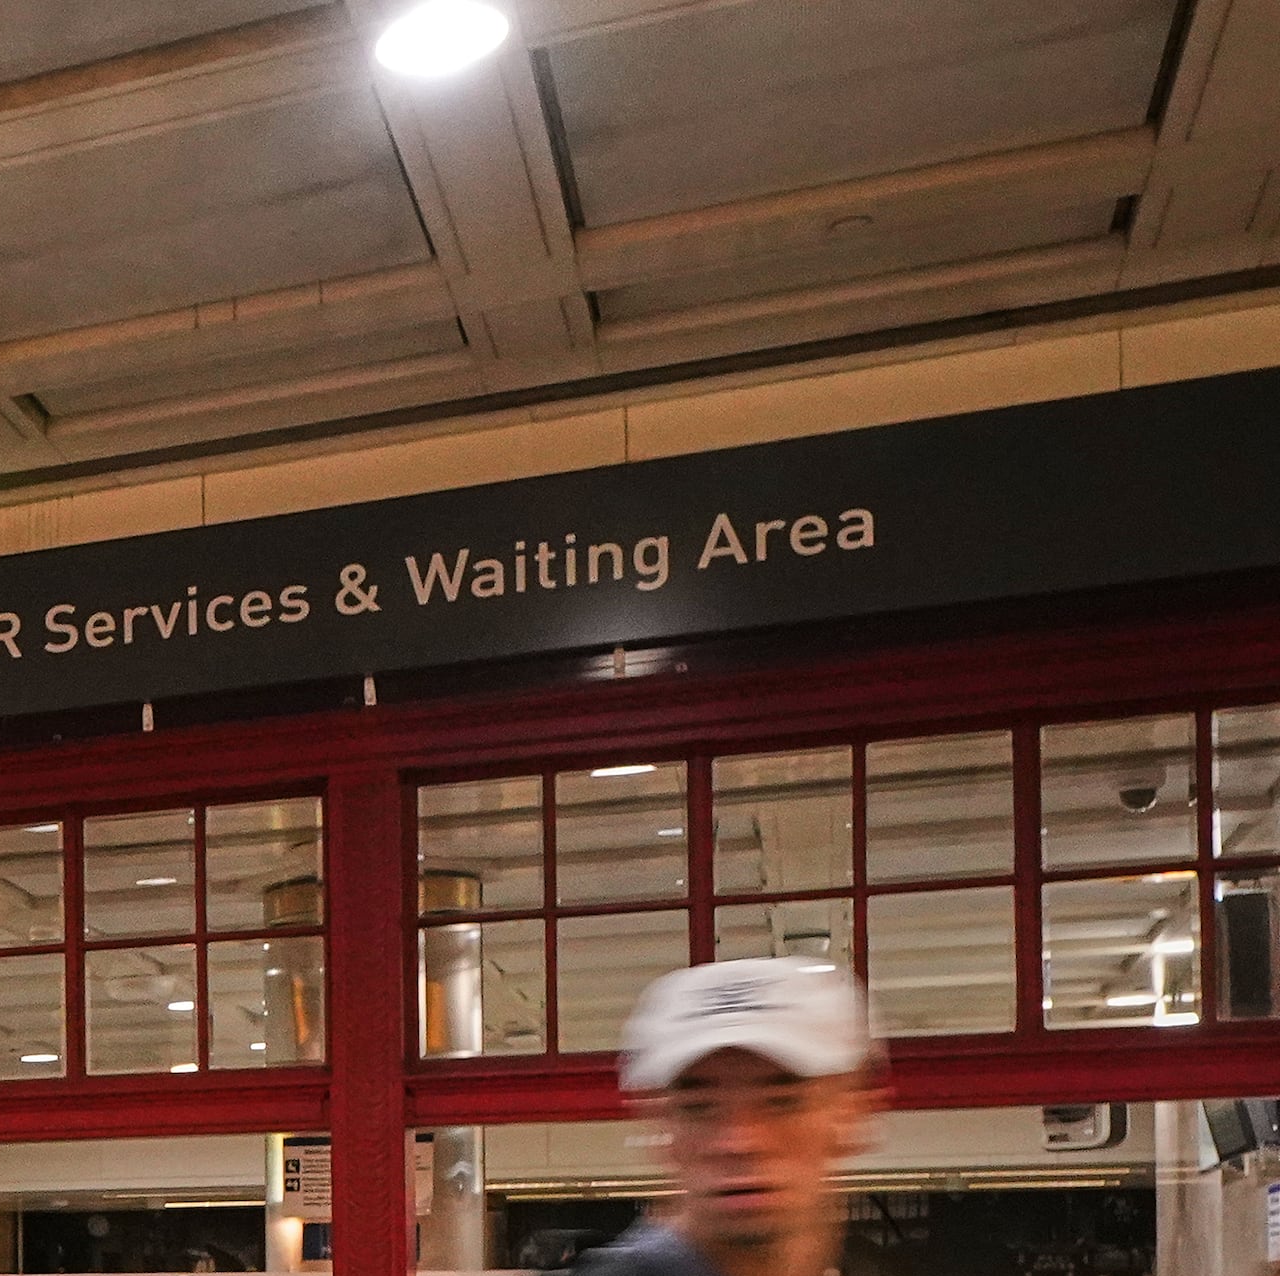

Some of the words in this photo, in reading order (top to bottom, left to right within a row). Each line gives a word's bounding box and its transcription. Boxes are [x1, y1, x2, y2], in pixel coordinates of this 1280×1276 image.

[45, 586, 309, 653] Services
[336, 564, 381, 614] &
[405, 534, 668, 605] Waiting
[698, 509, 873, 569] Area
